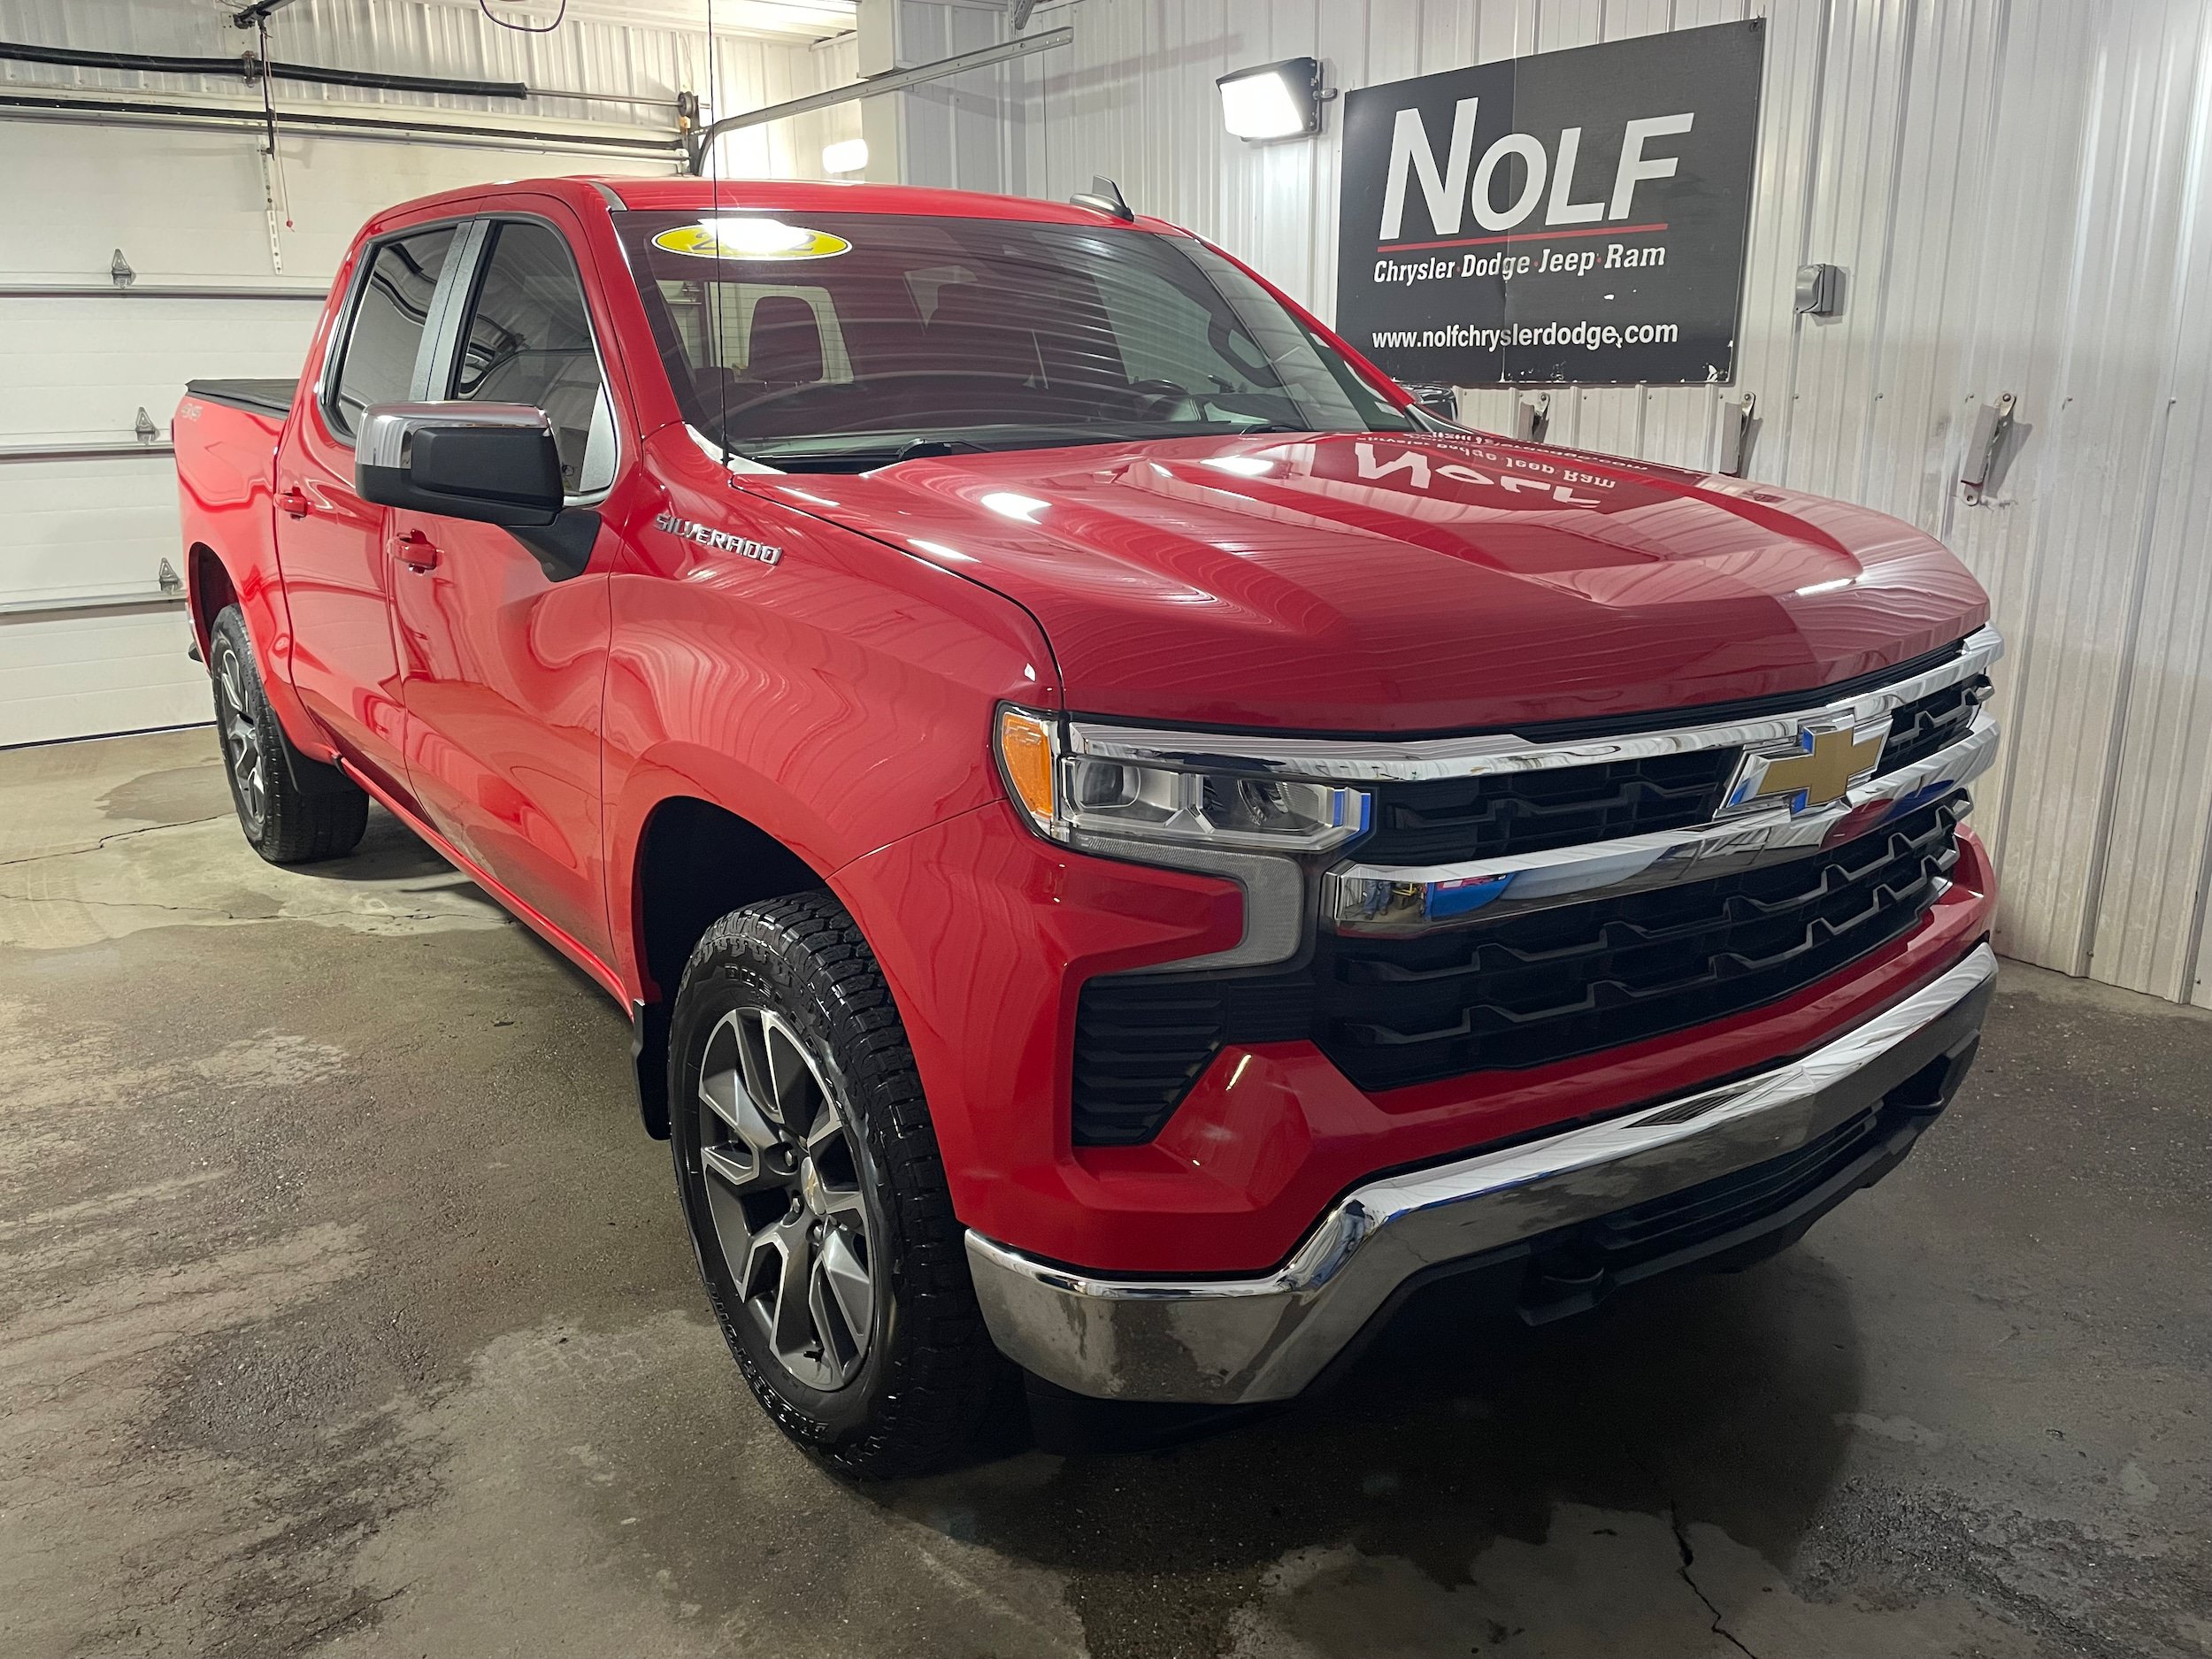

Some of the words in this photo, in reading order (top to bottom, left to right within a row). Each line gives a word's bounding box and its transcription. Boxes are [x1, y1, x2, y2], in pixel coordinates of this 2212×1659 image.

[1379, 96, 1694, 241] NOLF
[1373, 257, 1455, 287] Chrysler
[1461, 252, 1530, 280] Dodge
[1538, 249, 1595, 277] Jeep
[1604, 243, 1666, 269] Ram
[1372, 320, 1678, 352] www.nolfchryslerdodge.com
[653, 512, 784, 566] SILVERADO
